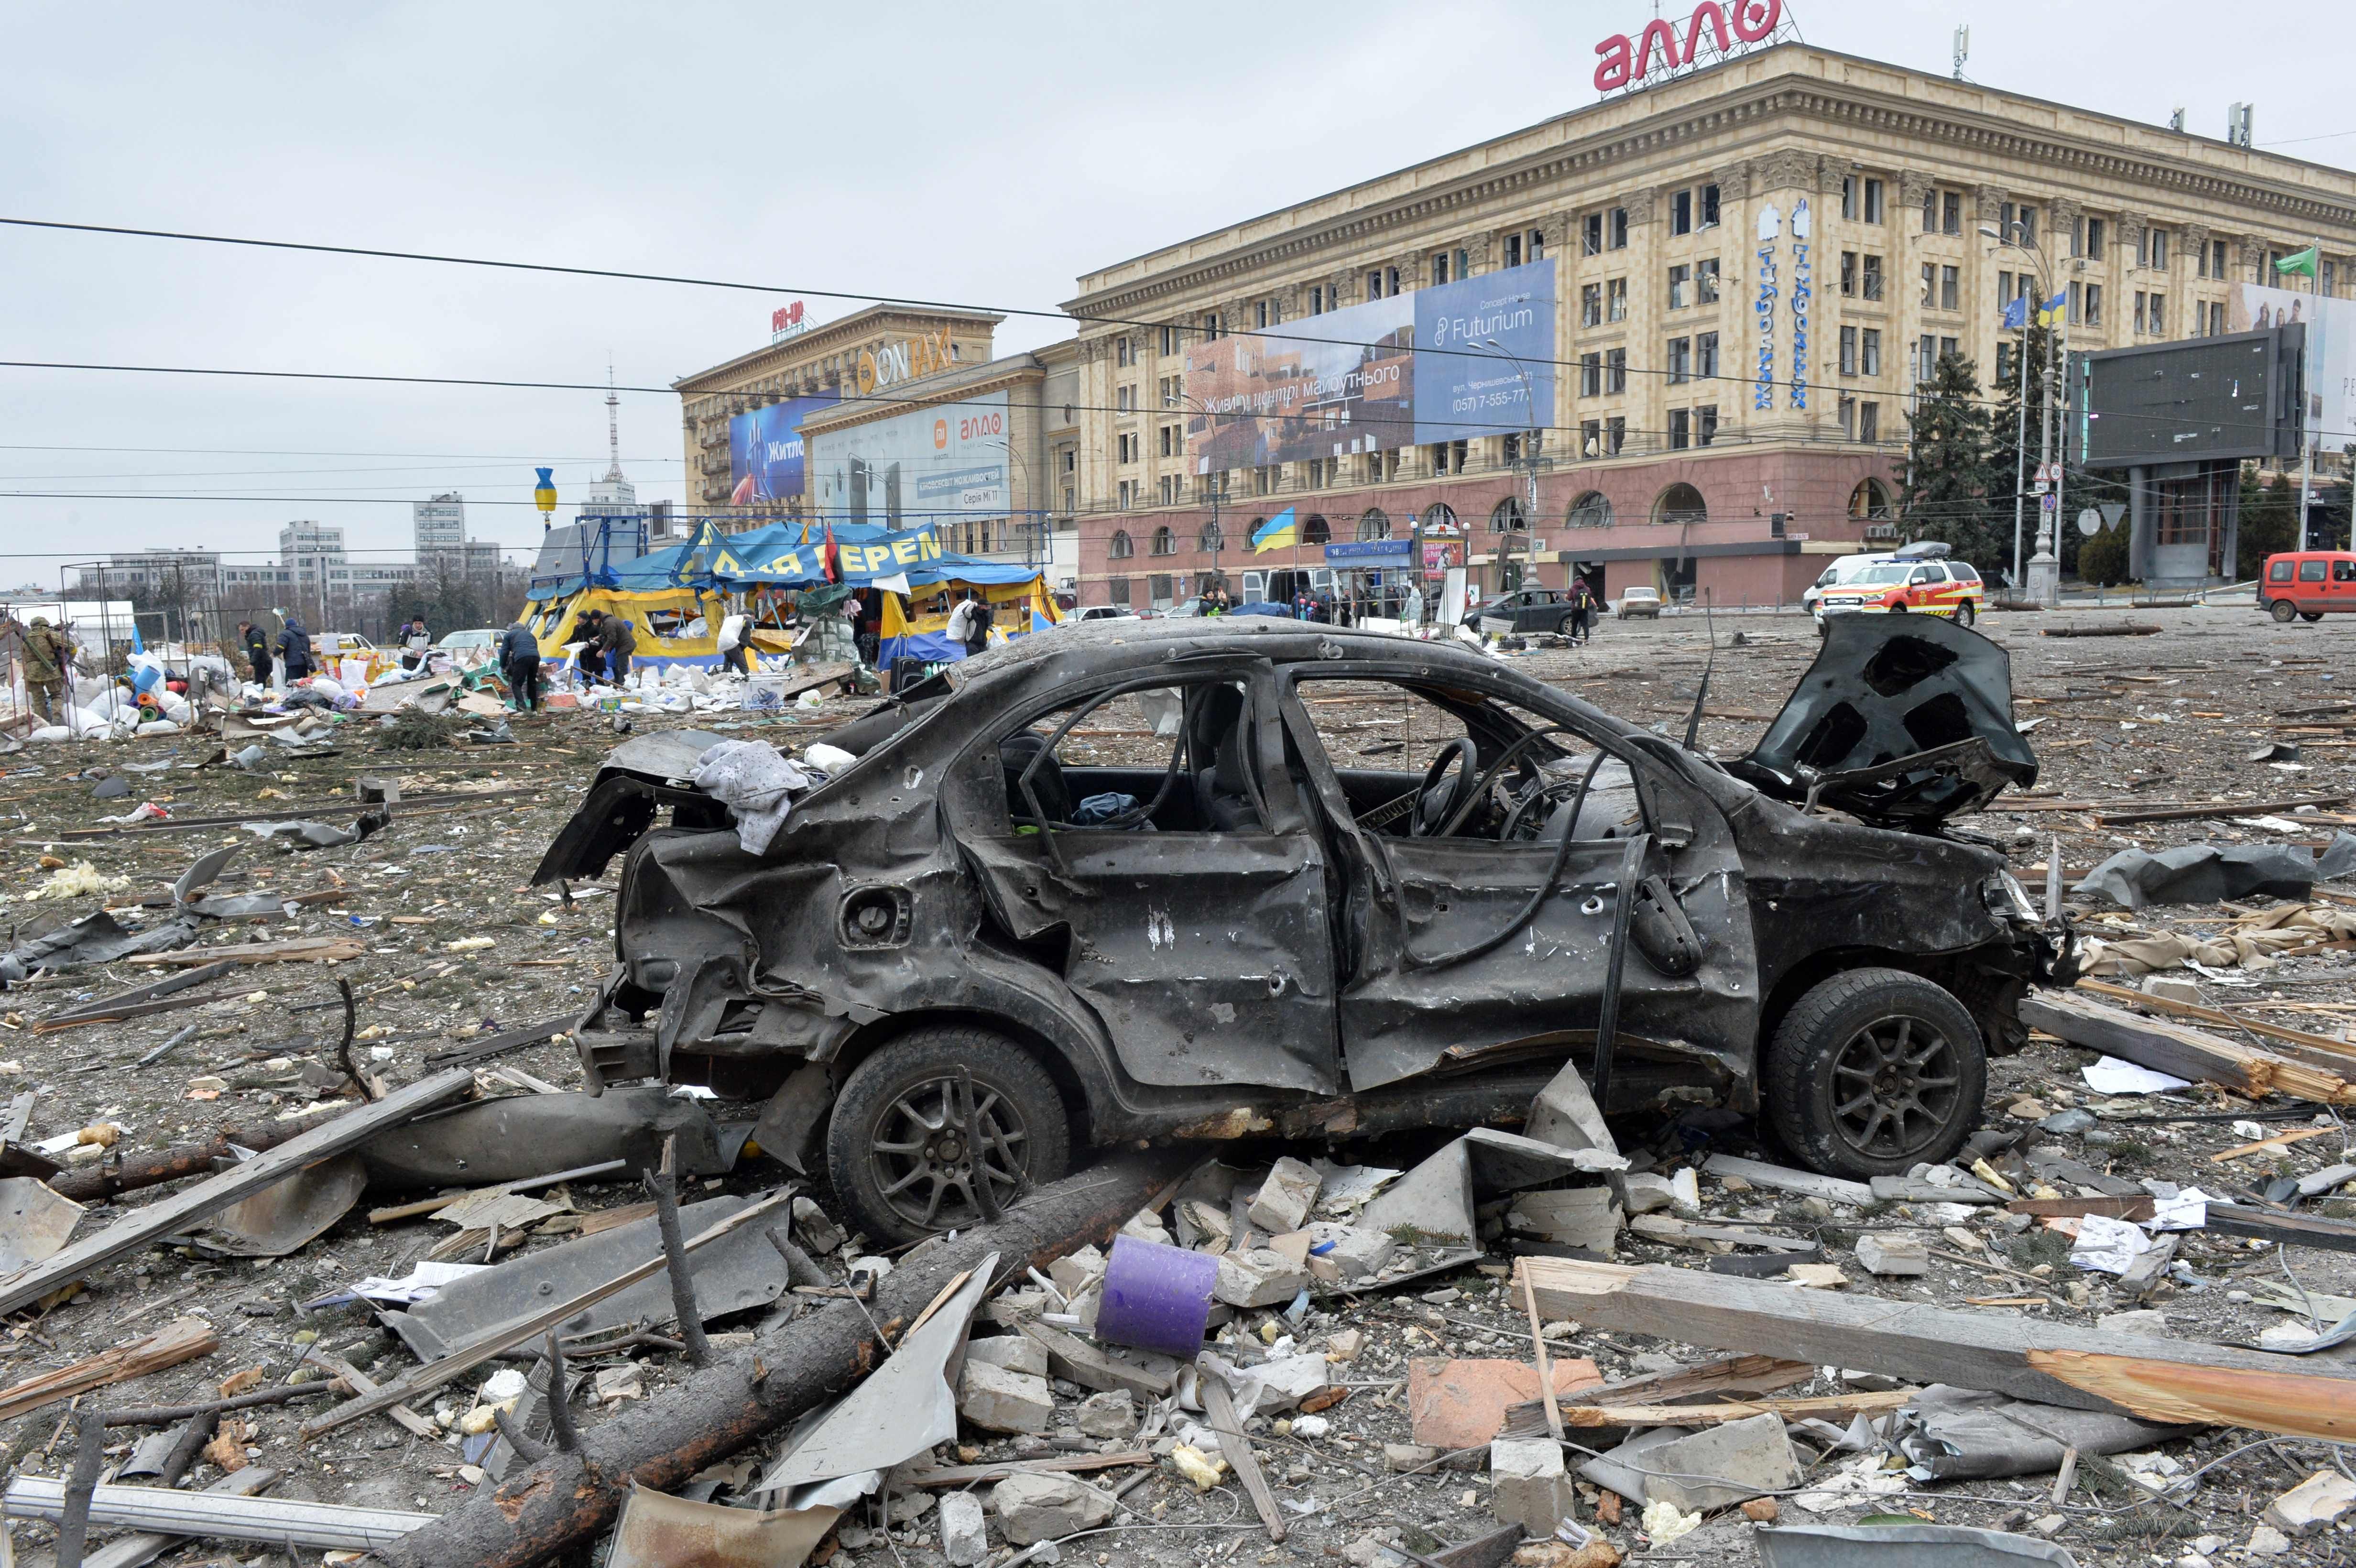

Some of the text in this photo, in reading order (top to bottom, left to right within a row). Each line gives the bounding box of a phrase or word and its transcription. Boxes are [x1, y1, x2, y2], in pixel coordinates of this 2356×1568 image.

[1480, 292, 1530, 310] Concept House
[1453, 309, 1532, 340] Futurium
[1204, 364, 1400, 415] Живи у центрі майбутнього
[1453, 384, 1467, 394] вул.
[1453, 388, 1532, 415] (057) 7-555-777
[768, 439, 804, 463] Житло
[919, 468, 1000, 491] КІНОВСЕСВІТ МОЖЛИВОСТЕЙ
[964, 492, 982, 505] Серія
[992, 490, 998, 501] 11
